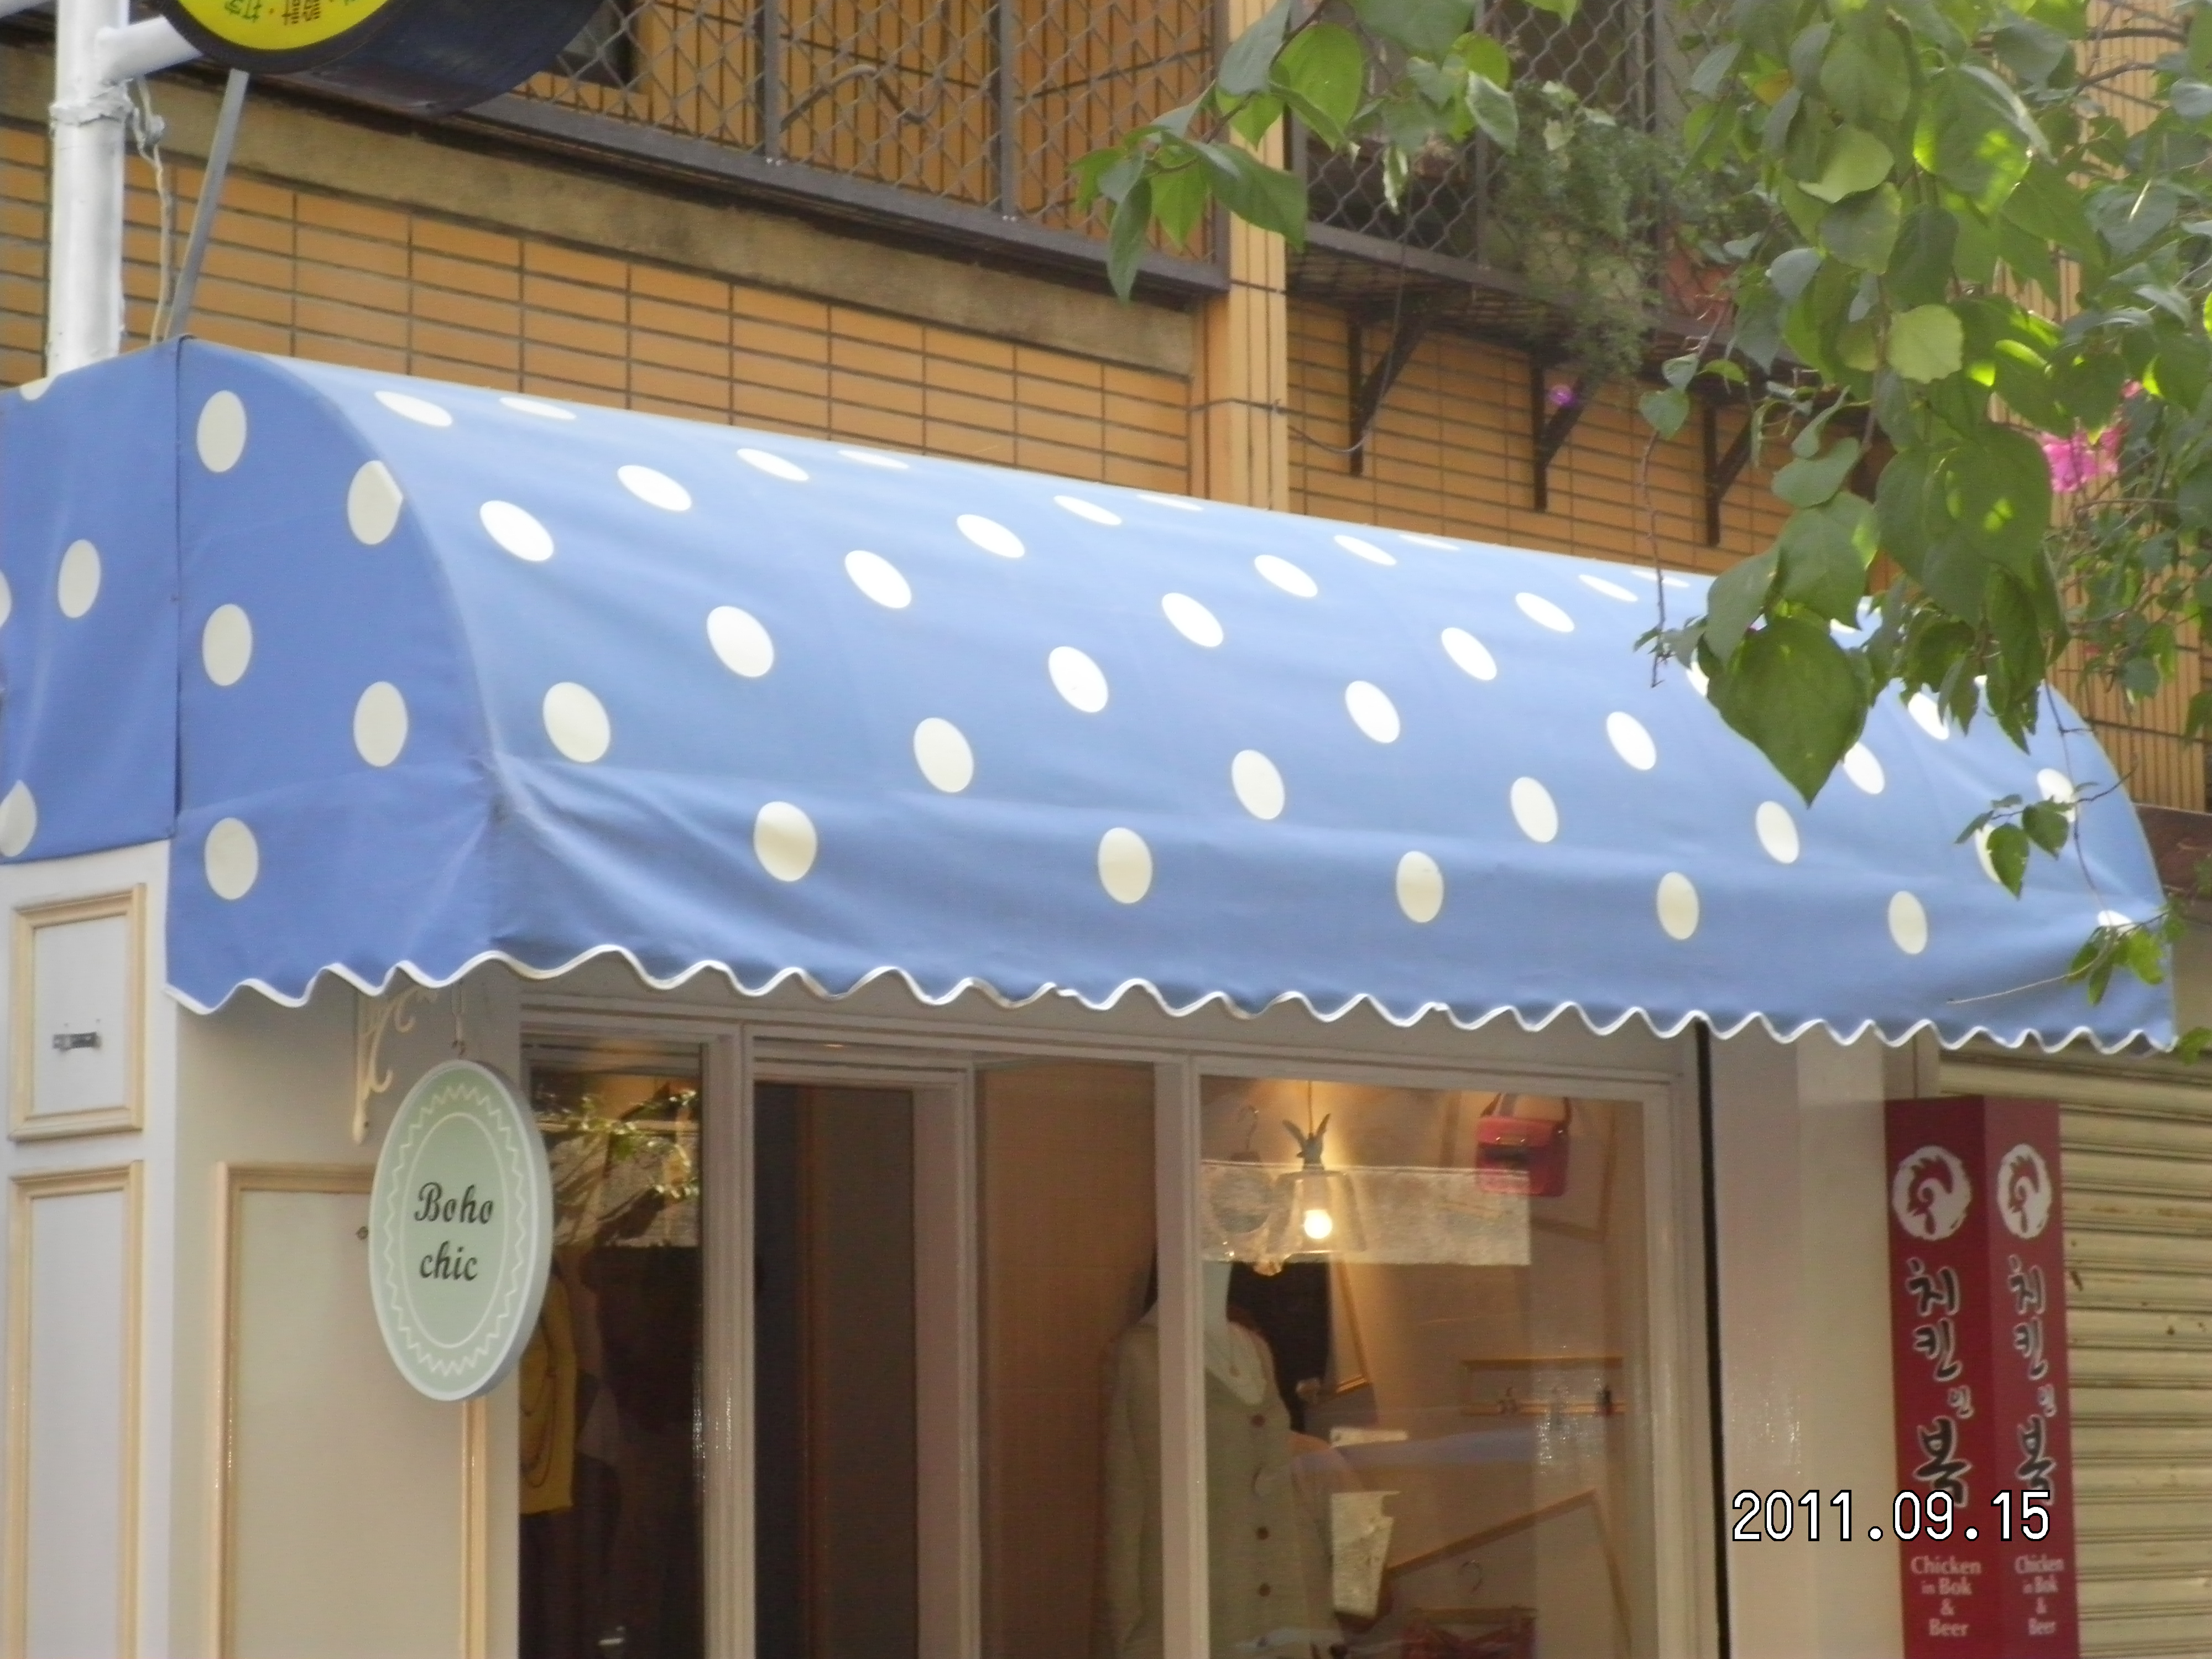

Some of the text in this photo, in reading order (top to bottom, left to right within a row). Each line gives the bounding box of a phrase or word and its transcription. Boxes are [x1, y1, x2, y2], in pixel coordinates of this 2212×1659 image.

[414, 1182, 494, 1224] Boho
[420, 1240, 478, 1281] chic
[1911, 1554, 1982, 1575] Chicken
[1929, 1618, 1970, 1637] Beer
